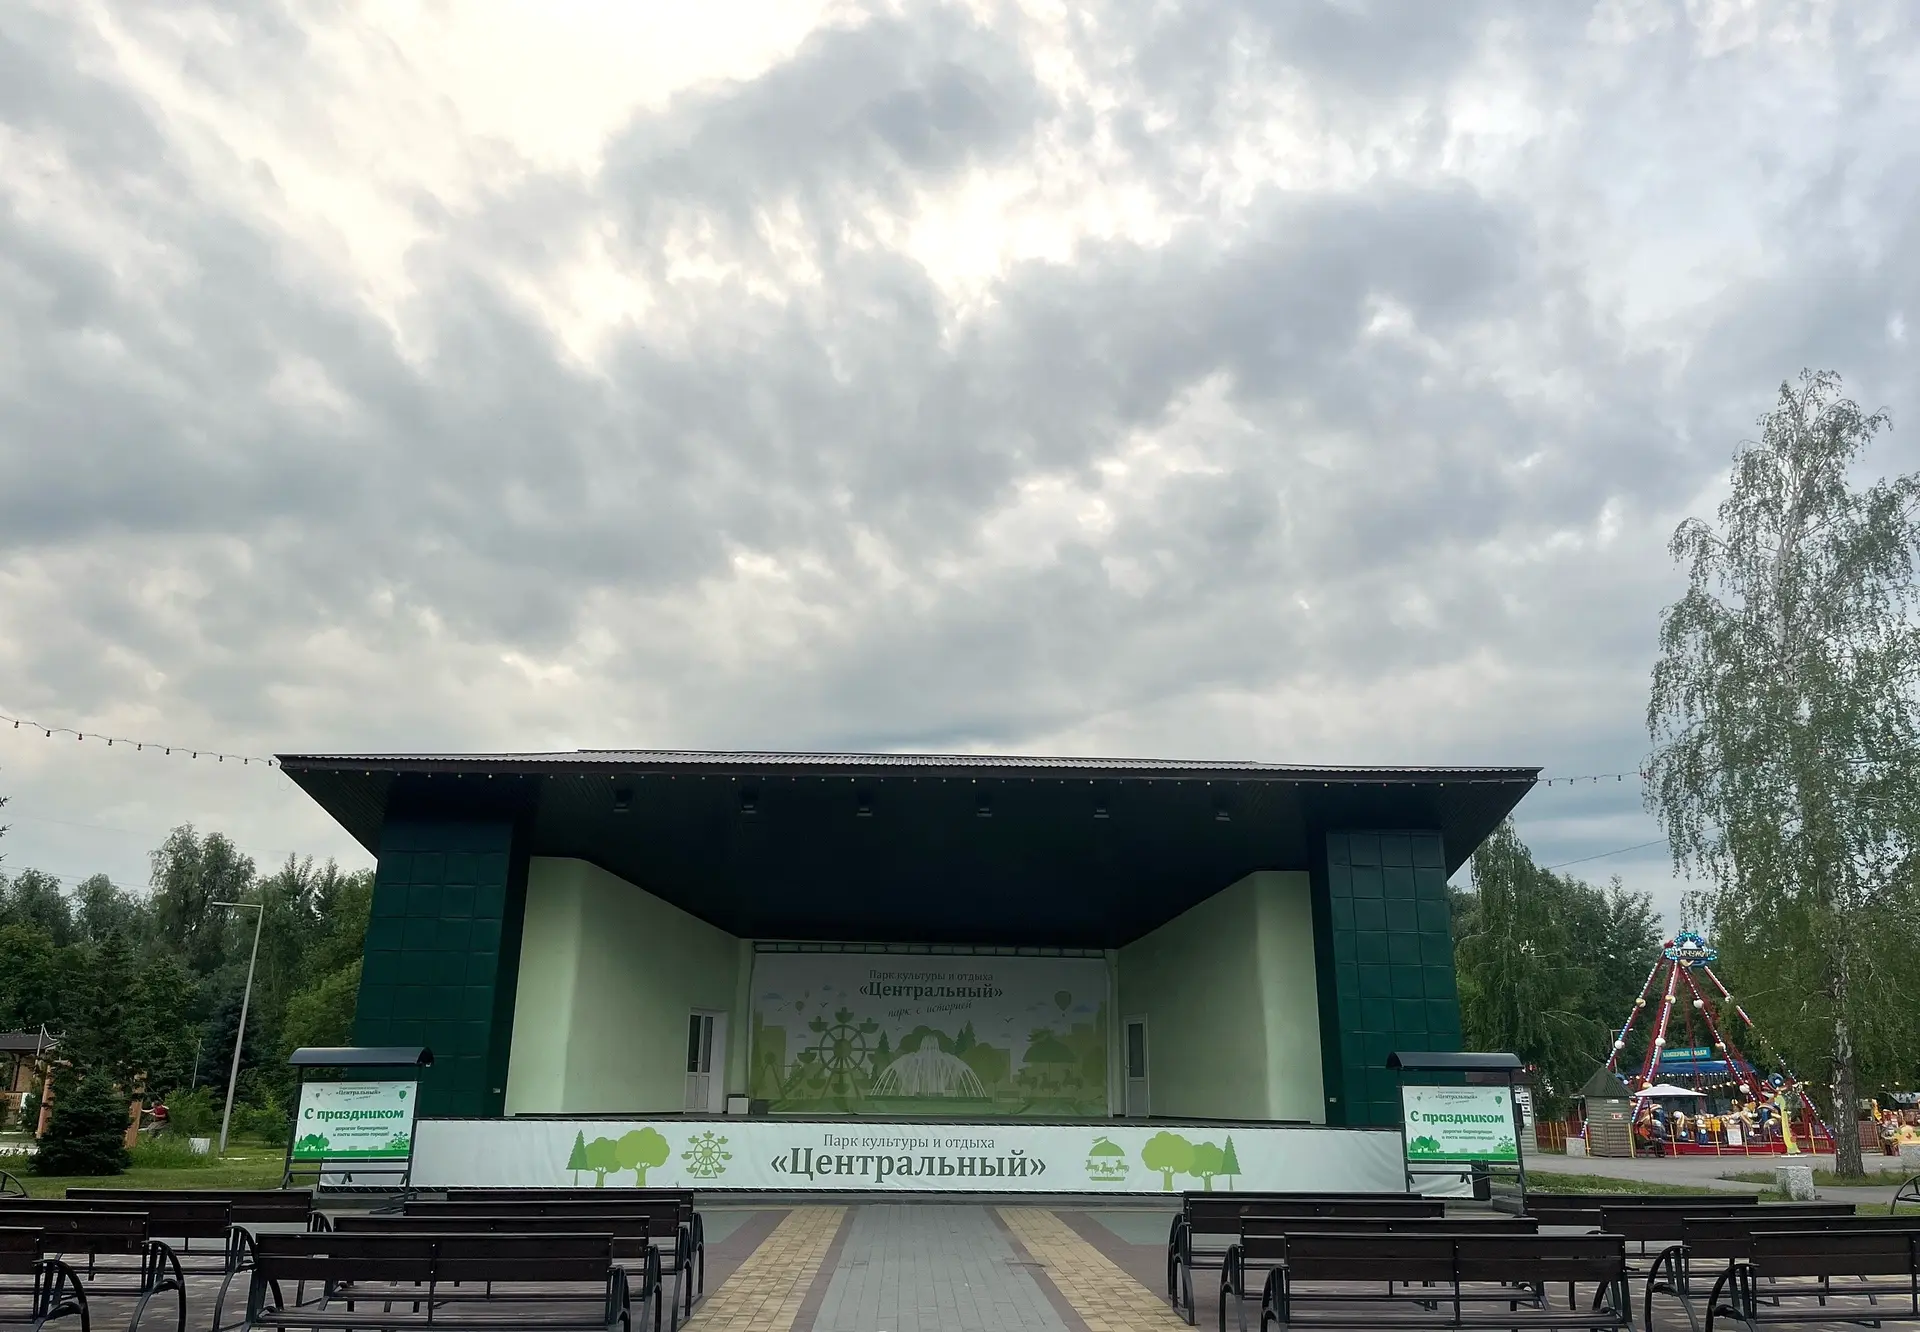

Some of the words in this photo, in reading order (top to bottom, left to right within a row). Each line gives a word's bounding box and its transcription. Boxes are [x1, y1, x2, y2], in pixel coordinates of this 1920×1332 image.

[869, 969, 894, 982] Парк
[895, 972, 945, 983] культуры
[948, 973, 955, 981] и
[957, 973, 993, 983] отдыха
[859, 982, 1003, 1000] «Центральный»
[888, 1007, 911, 1021] парк
[926, 1000, 972, 1015] историей
[305, 1108, 314, 1119] С
[317, 1109, 404, 1122] праздником
[1410, 1110, 1419, 1122] С
[1422, 1112, 1504, 1125] праздником
[823, 1133, 858, 1149] Парк
[861, 1135, 929, 1150] культуры
[933, 1137, 942, 1148] и
[945, 1137, 995, 1150] отдыха
[770, 1146, 1047, 1183] «Центральный»
